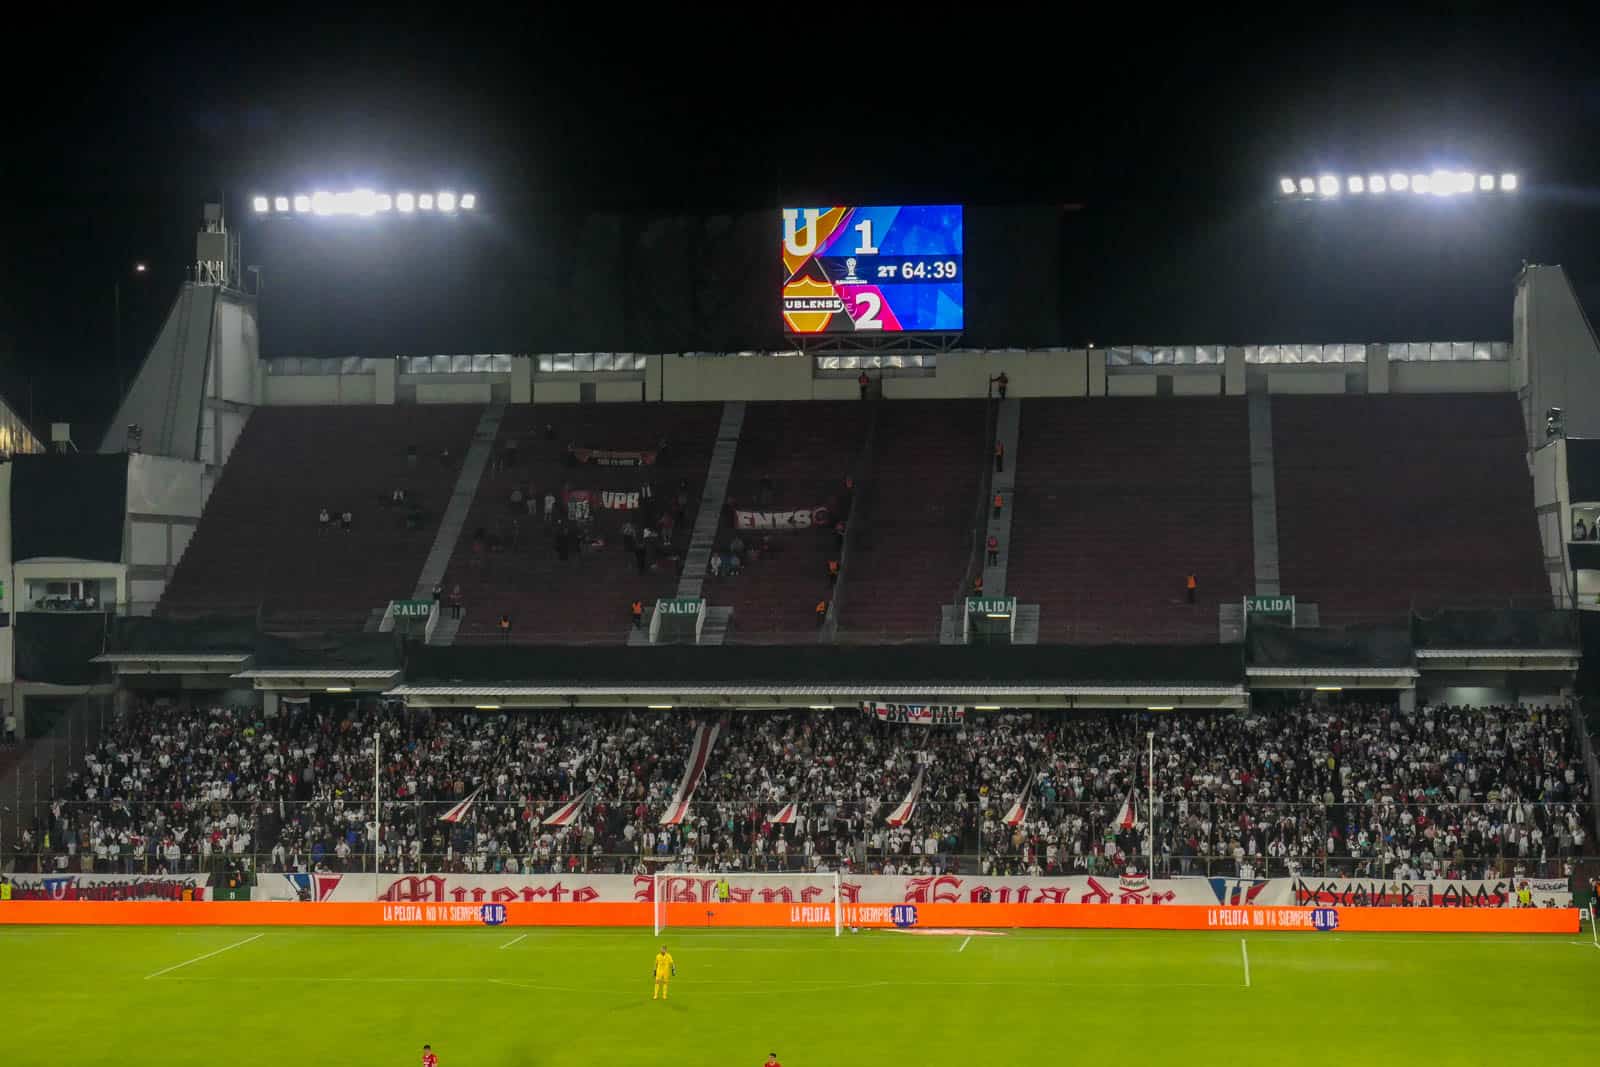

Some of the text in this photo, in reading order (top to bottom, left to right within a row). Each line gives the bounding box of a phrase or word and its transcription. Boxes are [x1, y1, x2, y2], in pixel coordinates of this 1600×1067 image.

[783, 208, 819, 256] U
[855, 219, 878, 254] 1
[877, 261, 957, 279] 2T 64:39
[855, 292, 882, 329] 2
[393, 604, 433, 615] SALID
[968, 600, 1014, 612] SALIDA
[1247, 599, 1292, 611] SALIDA
[378, 874, 600, 903] Muerte
[384, 906, 393, 921] LA
[394, 906, 422, 921] PELOTA
[450, 906, 482, 921] SIEMPRE
[485, 905, 493, 921] AL
[791, 907, 800, 922] LA
[801, 907, 831, 922] PELOTA
[859, 907, 892, 922] SIEMPRE
[895, 906, 904, 922] AL
[1208, 911, 1218, 926] LA
[1220, 911, 1249, 926] PELOTA
[1253, 911, 1265, 926] NO
[1279, 911, 1312, 926] SIEMPRE
[1315, 910, 1325, 926] AL
